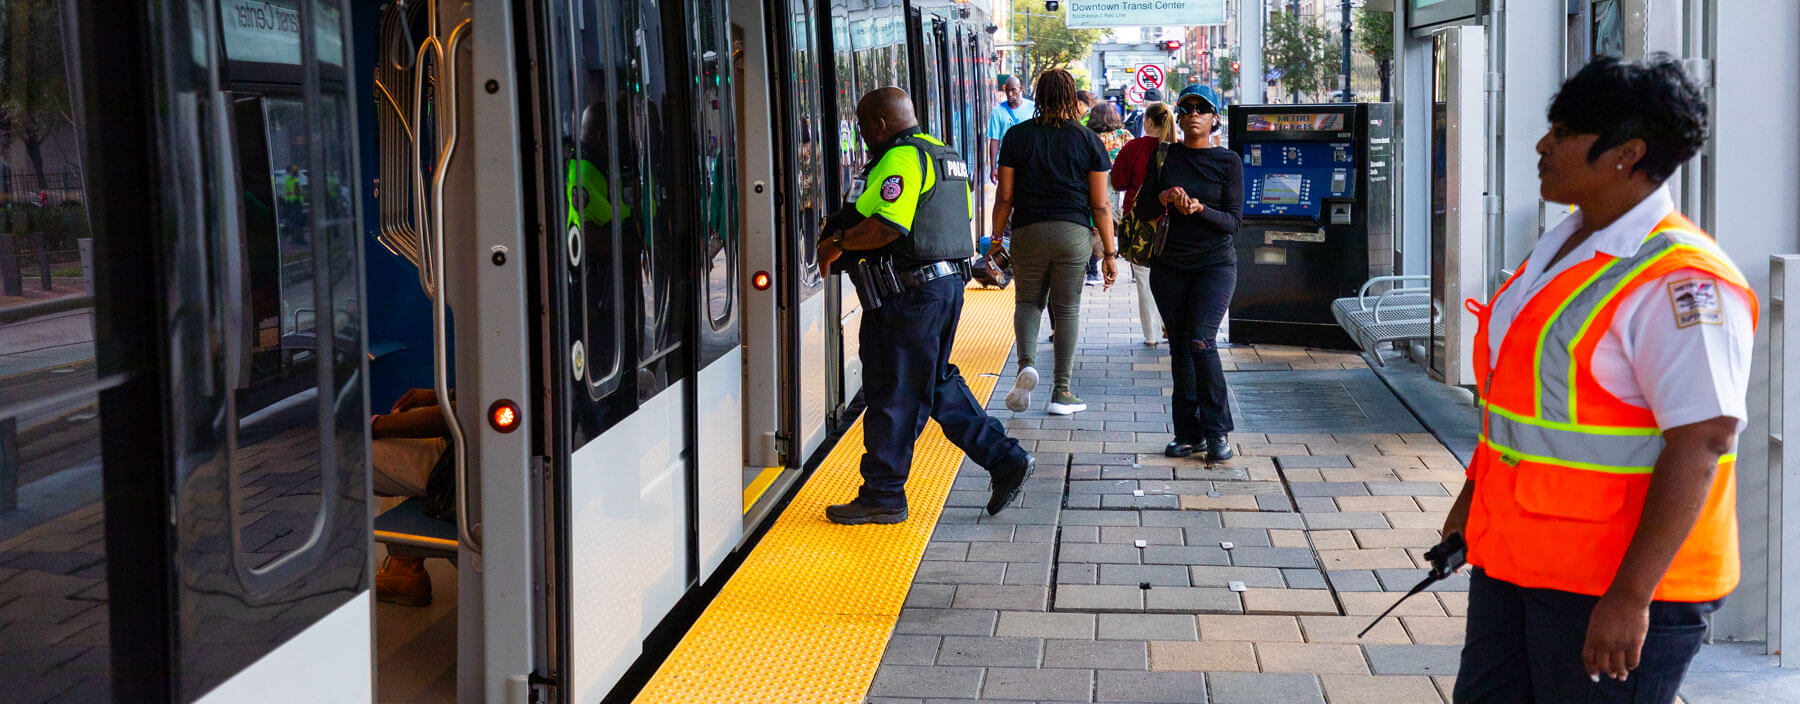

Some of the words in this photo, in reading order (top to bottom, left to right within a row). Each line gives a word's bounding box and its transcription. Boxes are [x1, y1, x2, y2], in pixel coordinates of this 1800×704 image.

[1072, 3, 1119, 12] Downtown
[1123, 2, 1152, 10] Transit
[1155, 1, 1185, 10] Center
[1273, 122, 1313, 131] Tickets
